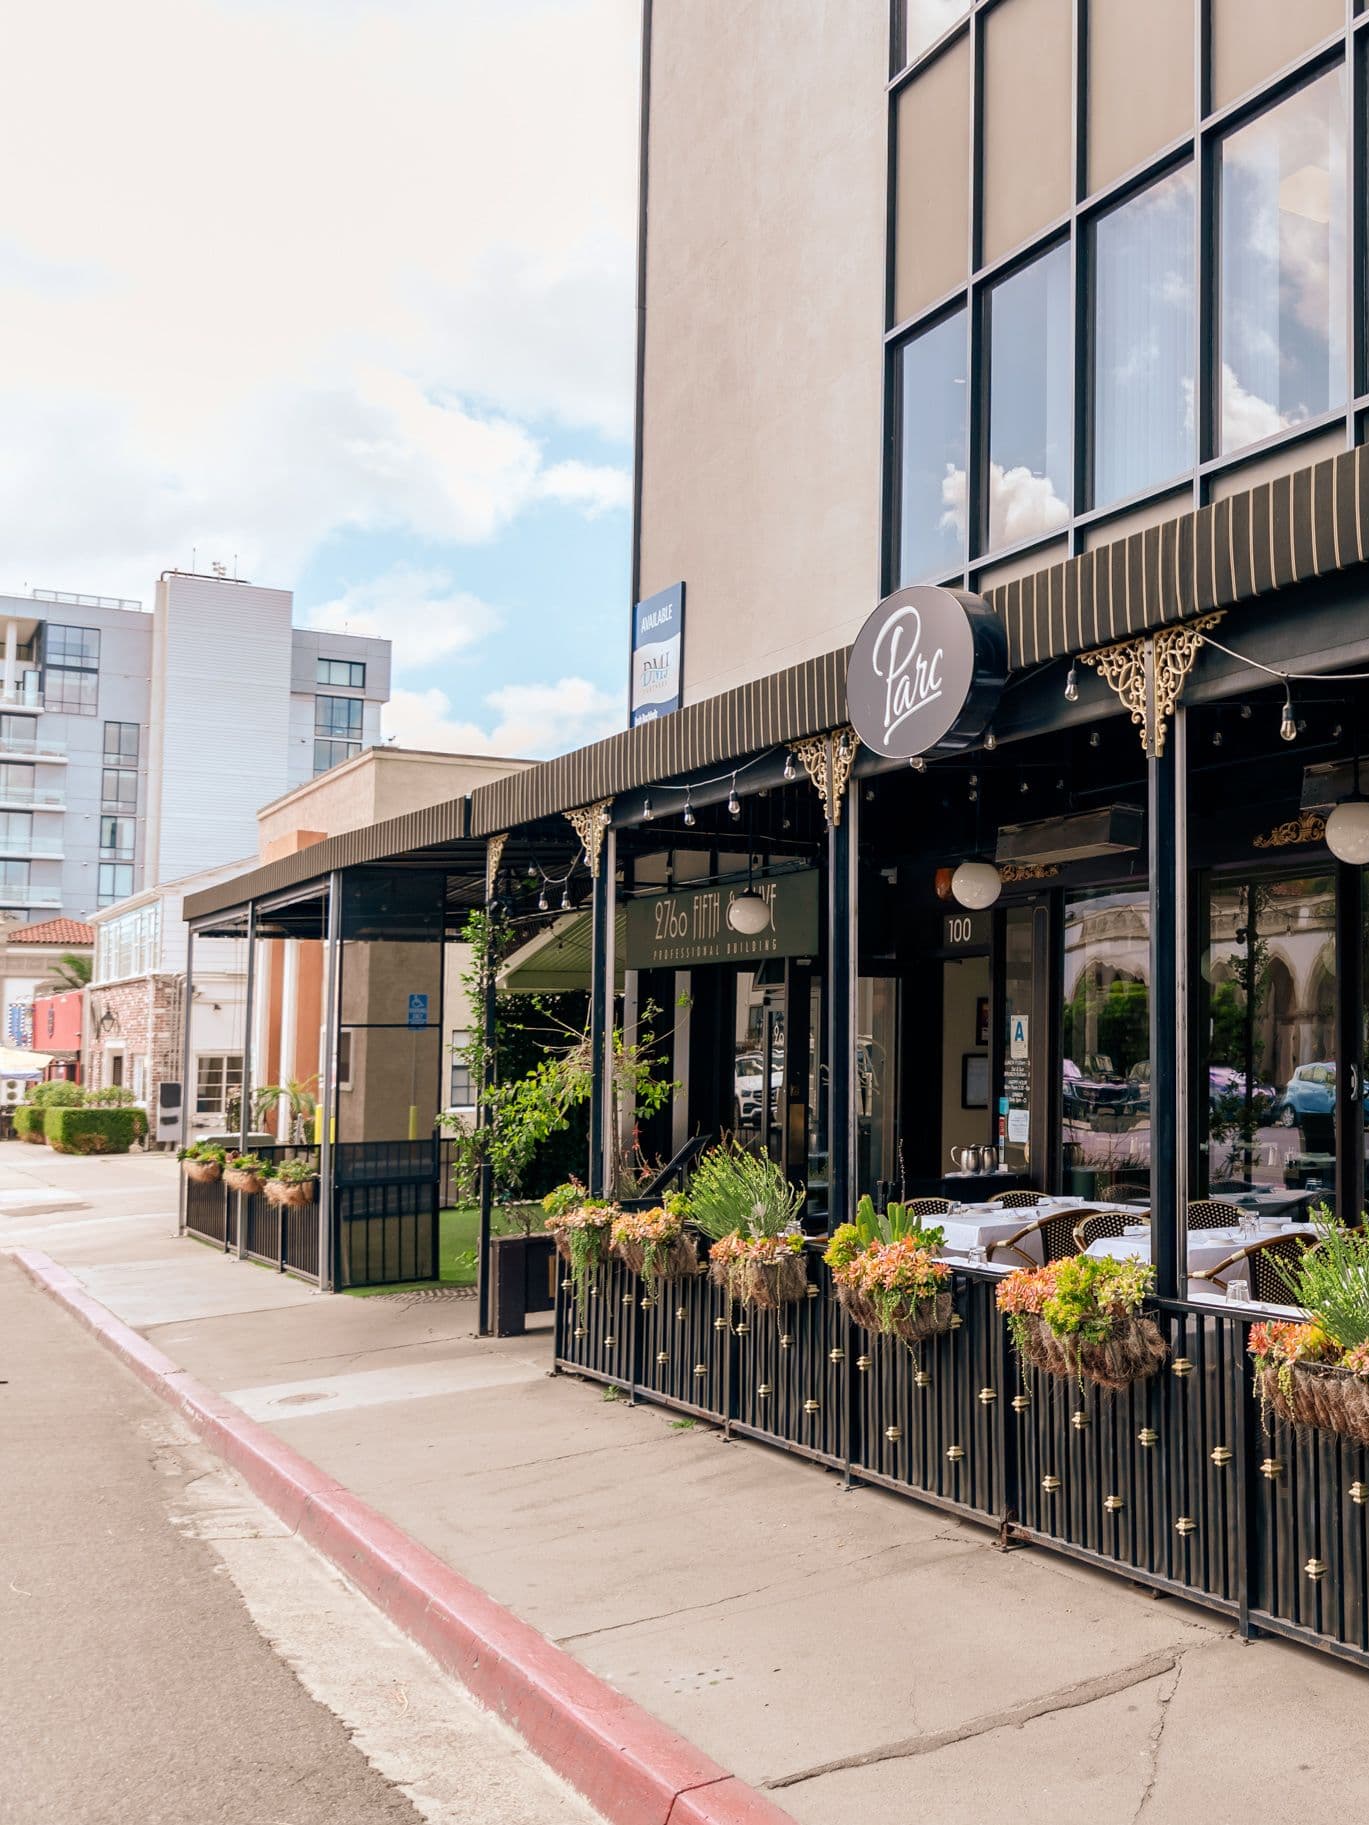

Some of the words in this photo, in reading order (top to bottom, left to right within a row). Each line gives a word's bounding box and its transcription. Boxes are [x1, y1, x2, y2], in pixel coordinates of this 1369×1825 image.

[641, 603, 673, 633] AVAILABLE
[873, 605, 944, 728] Parc
[655, 898, 688, 940] 2760
[693, 891, 720, 940] FIFTH
[948, 917, 972, 943] 100
[653, 944, 719, 961] PROFESSIONAL
[727, 938, 777, 954] BUILDING
[1014, 1020, 1025, 1042] A
